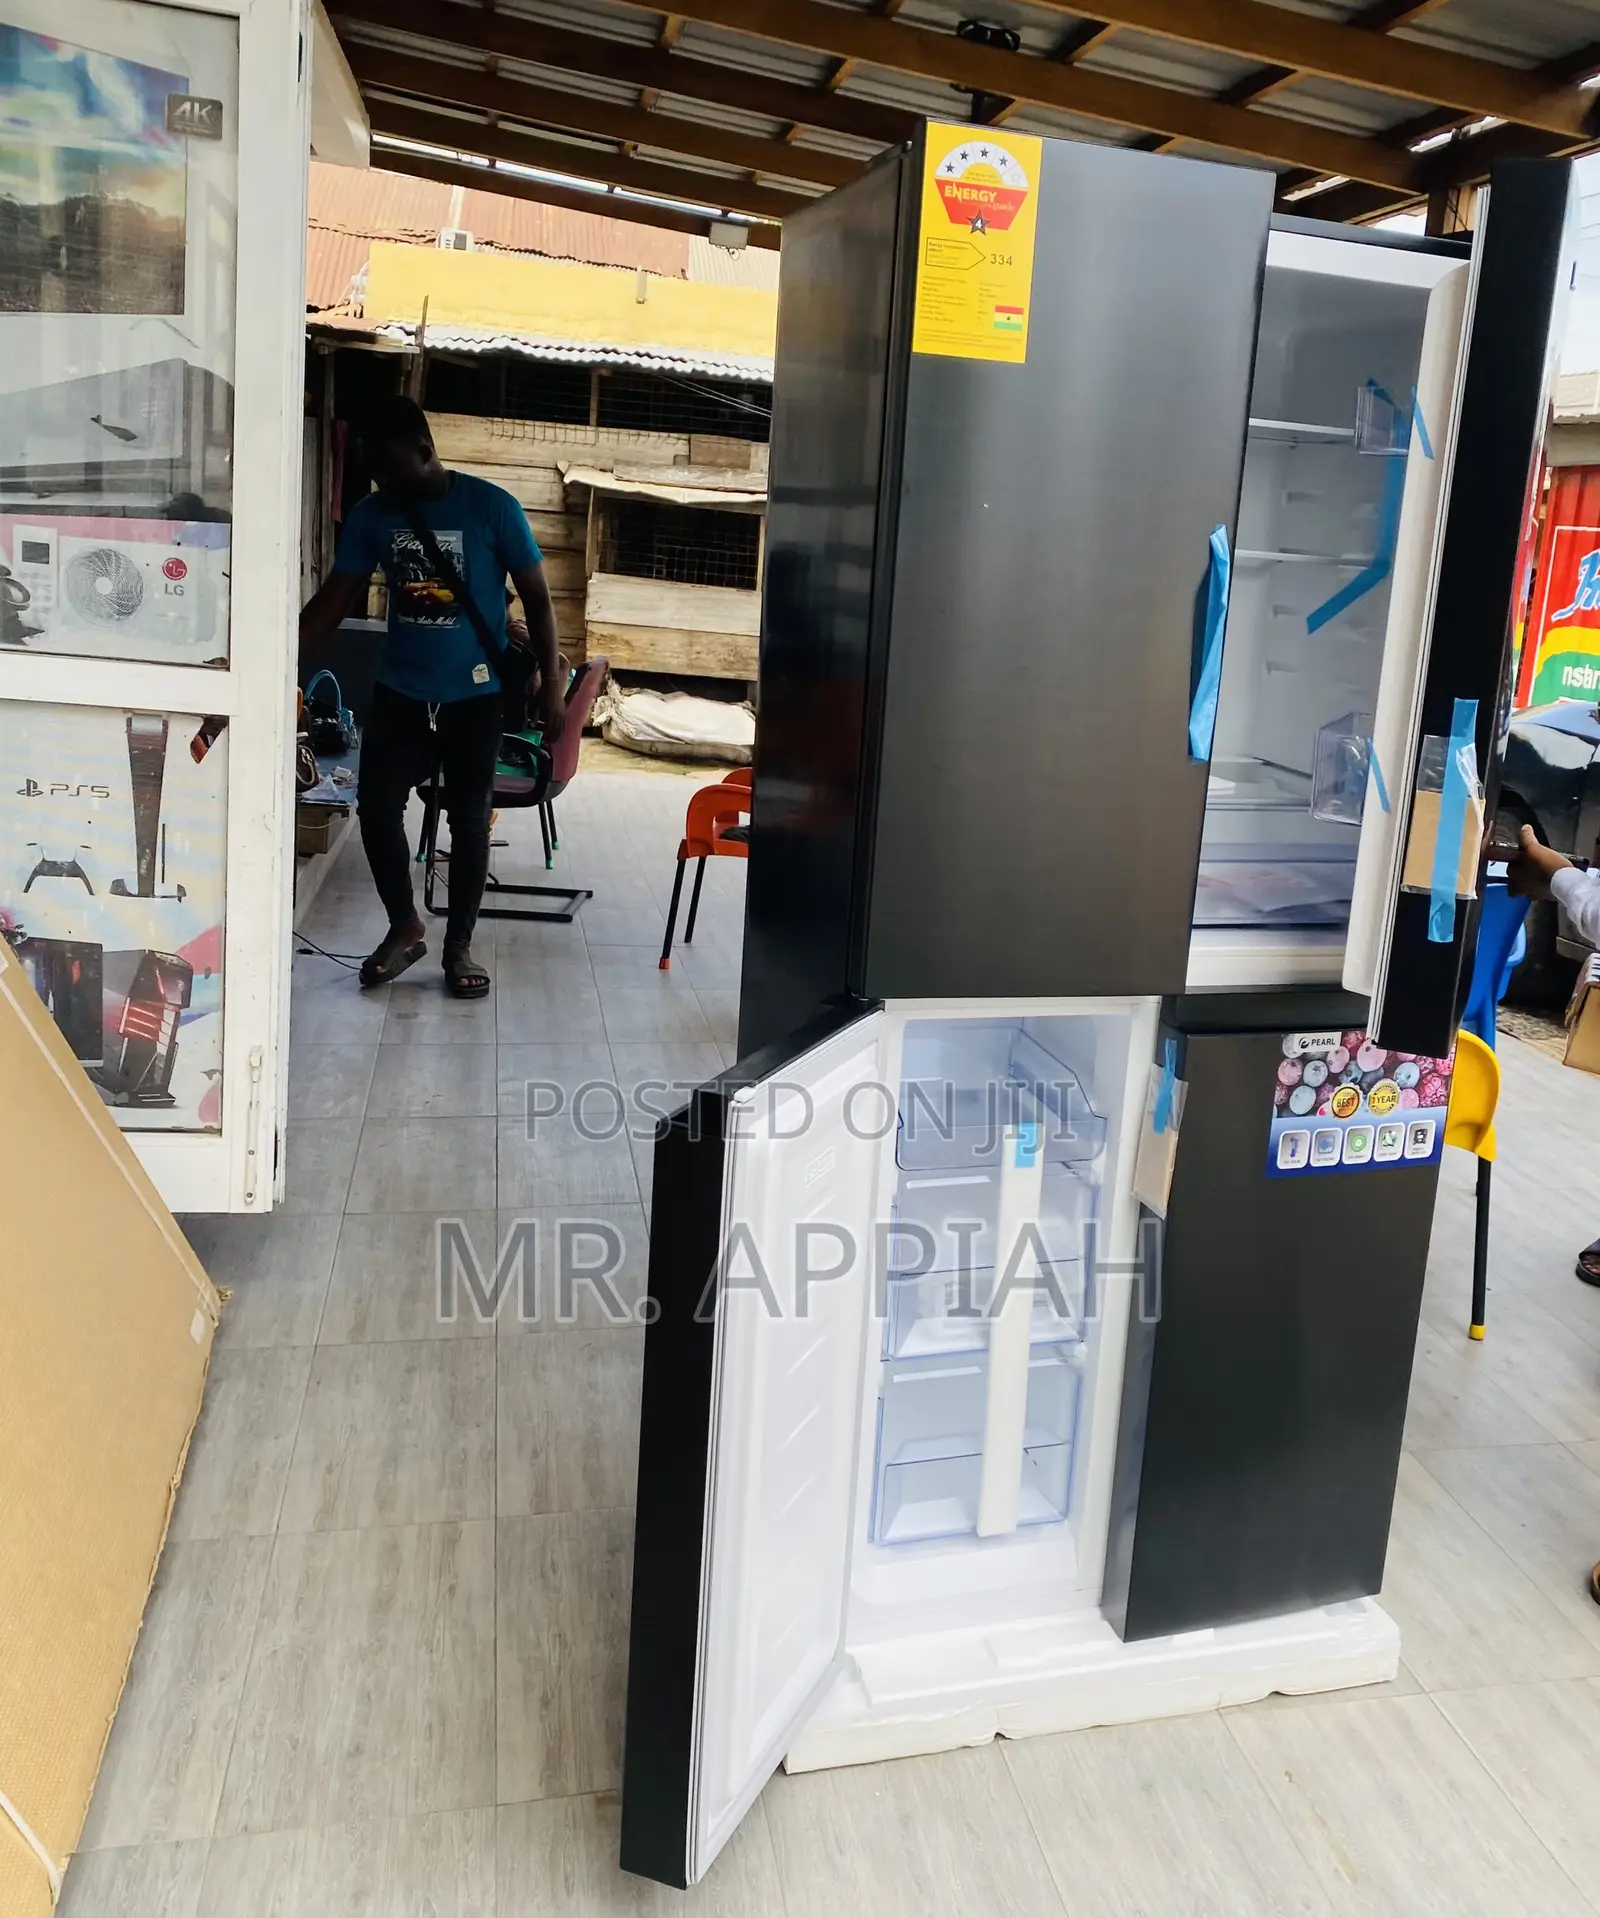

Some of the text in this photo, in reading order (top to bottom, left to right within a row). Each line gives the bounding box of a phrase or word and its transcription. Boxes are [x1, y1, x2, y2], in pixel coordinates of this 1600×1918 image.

[172, 100, 213, 124] 4K
[944, 181, 997, 203] ENERGY
[975, 218, 983, 229] 4
[990, 253, 1012, 266] 334
[164, 583, 185, 597] LG
[49, 783, 110, 799] PS5
[1311, 1038, 1336, 1047] PEARL
[1336, 1096, 1356, 1108] BEST
[1376, 1095, 1397, 1104] YEAR
